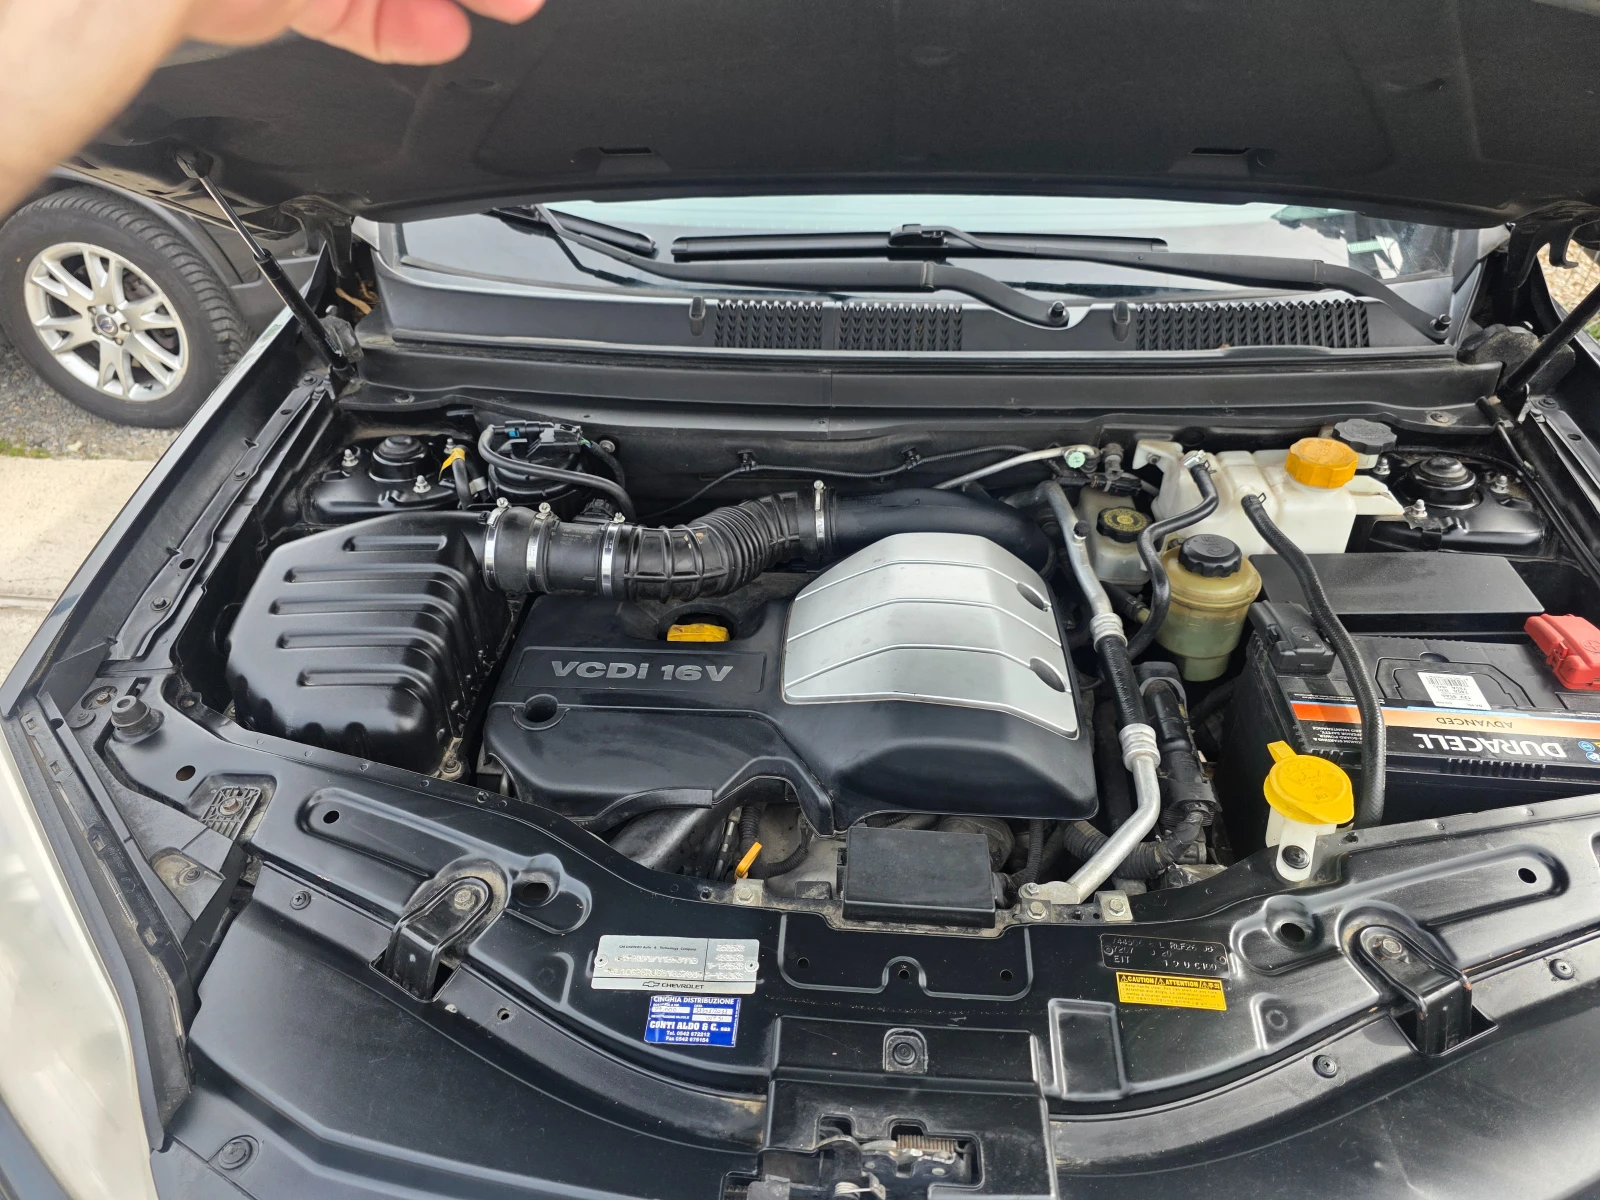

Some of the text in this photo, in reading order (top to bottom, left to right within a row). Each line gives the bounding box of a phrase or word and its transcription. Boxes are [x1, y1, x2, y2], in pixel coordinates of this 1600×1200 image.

[551, 661, 733, 682] VCDi 16V
[1436, 717, 1513, 729] ADVANCED
[1413, 733, 1567, 758] DURACELL
[1166, 980, 1199, 988] ATTENTION
[683, 997, 735, 1005] DISTRIBUZIONE
[650, 1020, 675, 1029] CONTI
[676, 1021, 700, 1030] ALDO
[702, 1022, 708, 1031] &
[710, 1023, 718, 1031] C.
